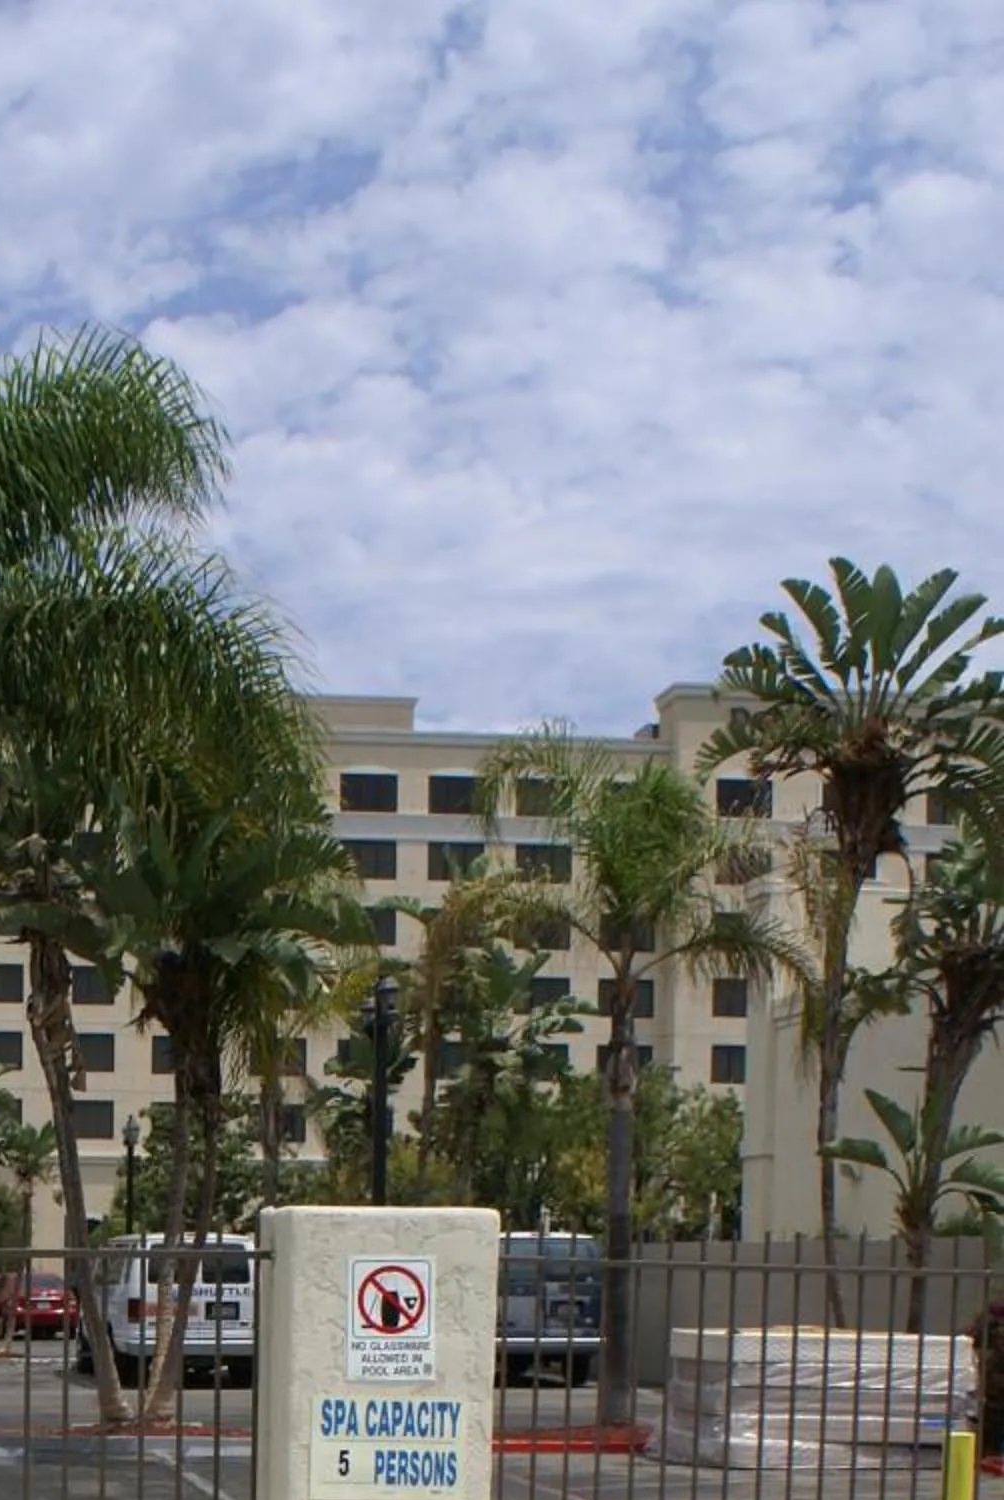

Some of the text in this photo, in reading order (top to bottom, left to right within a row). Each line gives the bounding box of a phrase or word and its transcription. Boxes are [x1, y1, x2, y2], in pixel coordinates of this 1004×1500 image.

[351, 1341, 431, 1350] NO GLASSWARE
[361, 1353, 423, 1363] ALLOWED IN
[362, 1365, 388, 1376] POOL
[393, 1365, 420, 1376] AREA
[320, 1399, 462, 1438] SPA CAPACITY
[338, 1449, 458, 1487] 5 PERSONS
